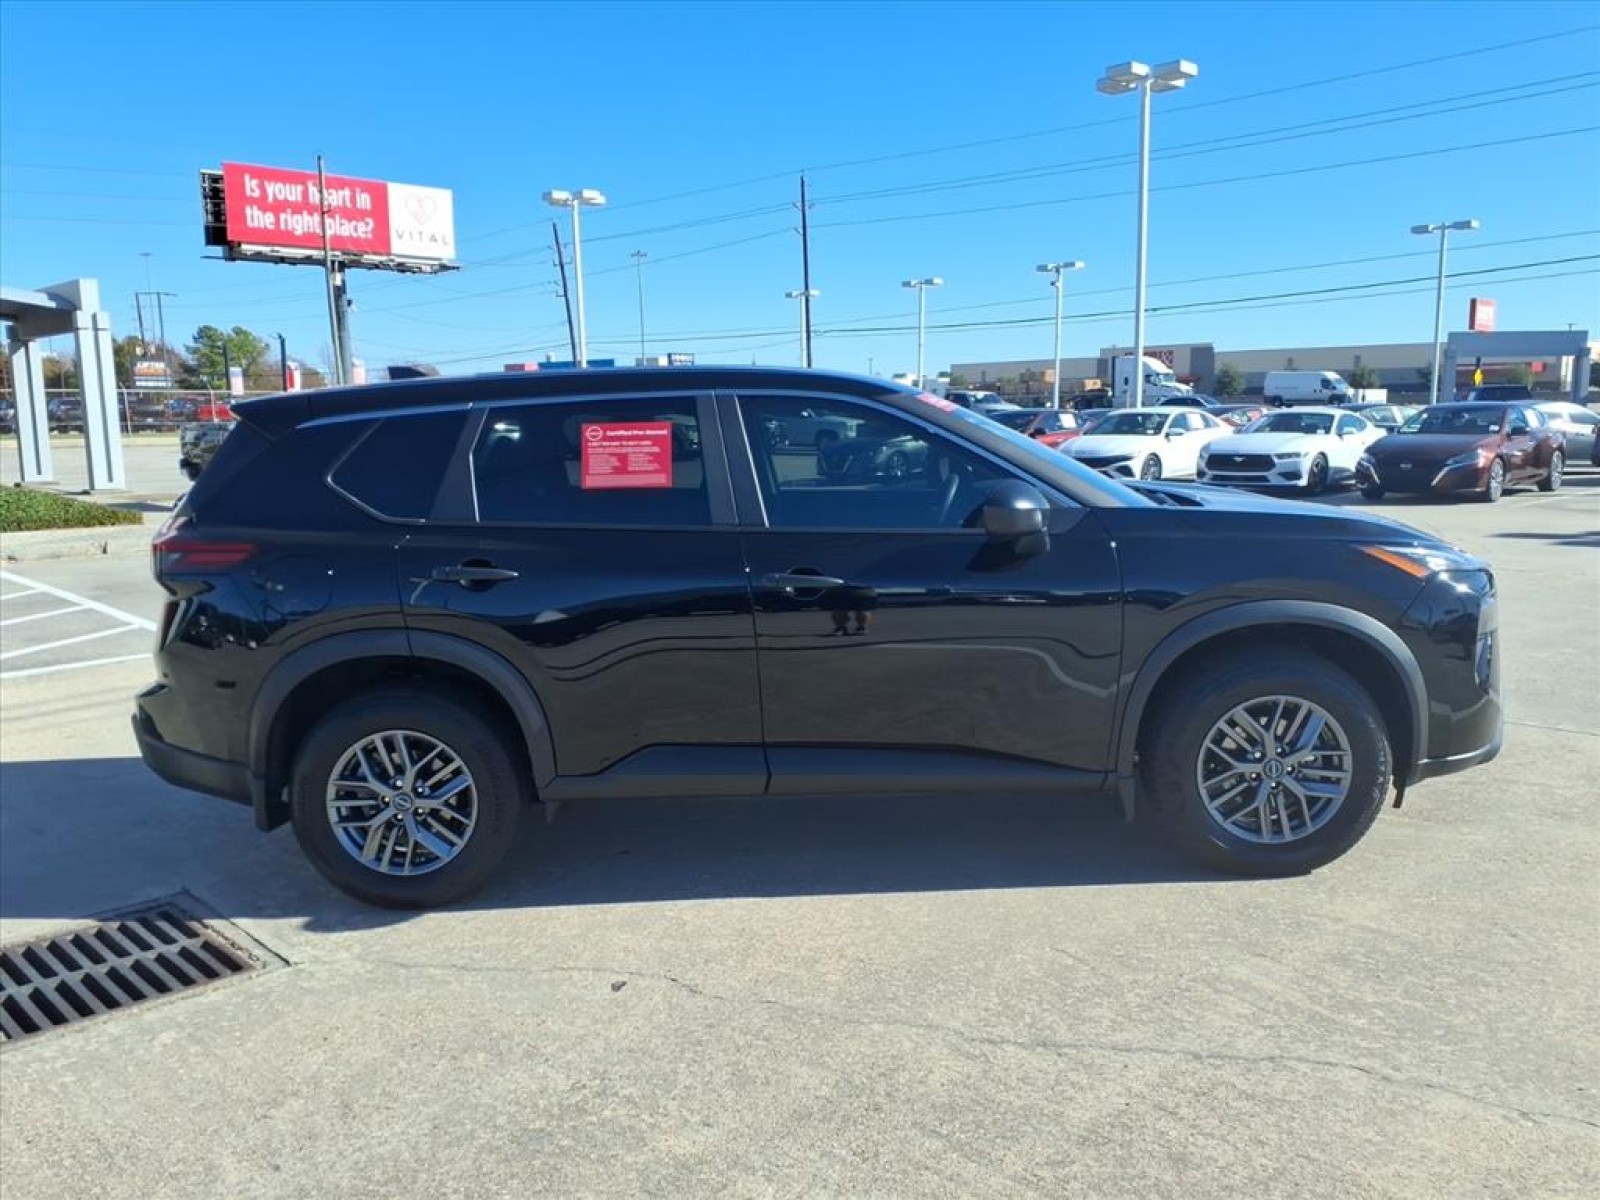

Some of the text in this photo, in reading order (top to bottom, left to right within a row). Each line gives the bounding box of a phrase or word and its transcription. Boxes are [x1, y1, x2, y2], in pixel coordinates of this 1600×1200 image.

[244, 174, 371, 211] Is your hart in
[245, 205, 374, 239] the right place?
[396, 230, 450, 246] VITAL
